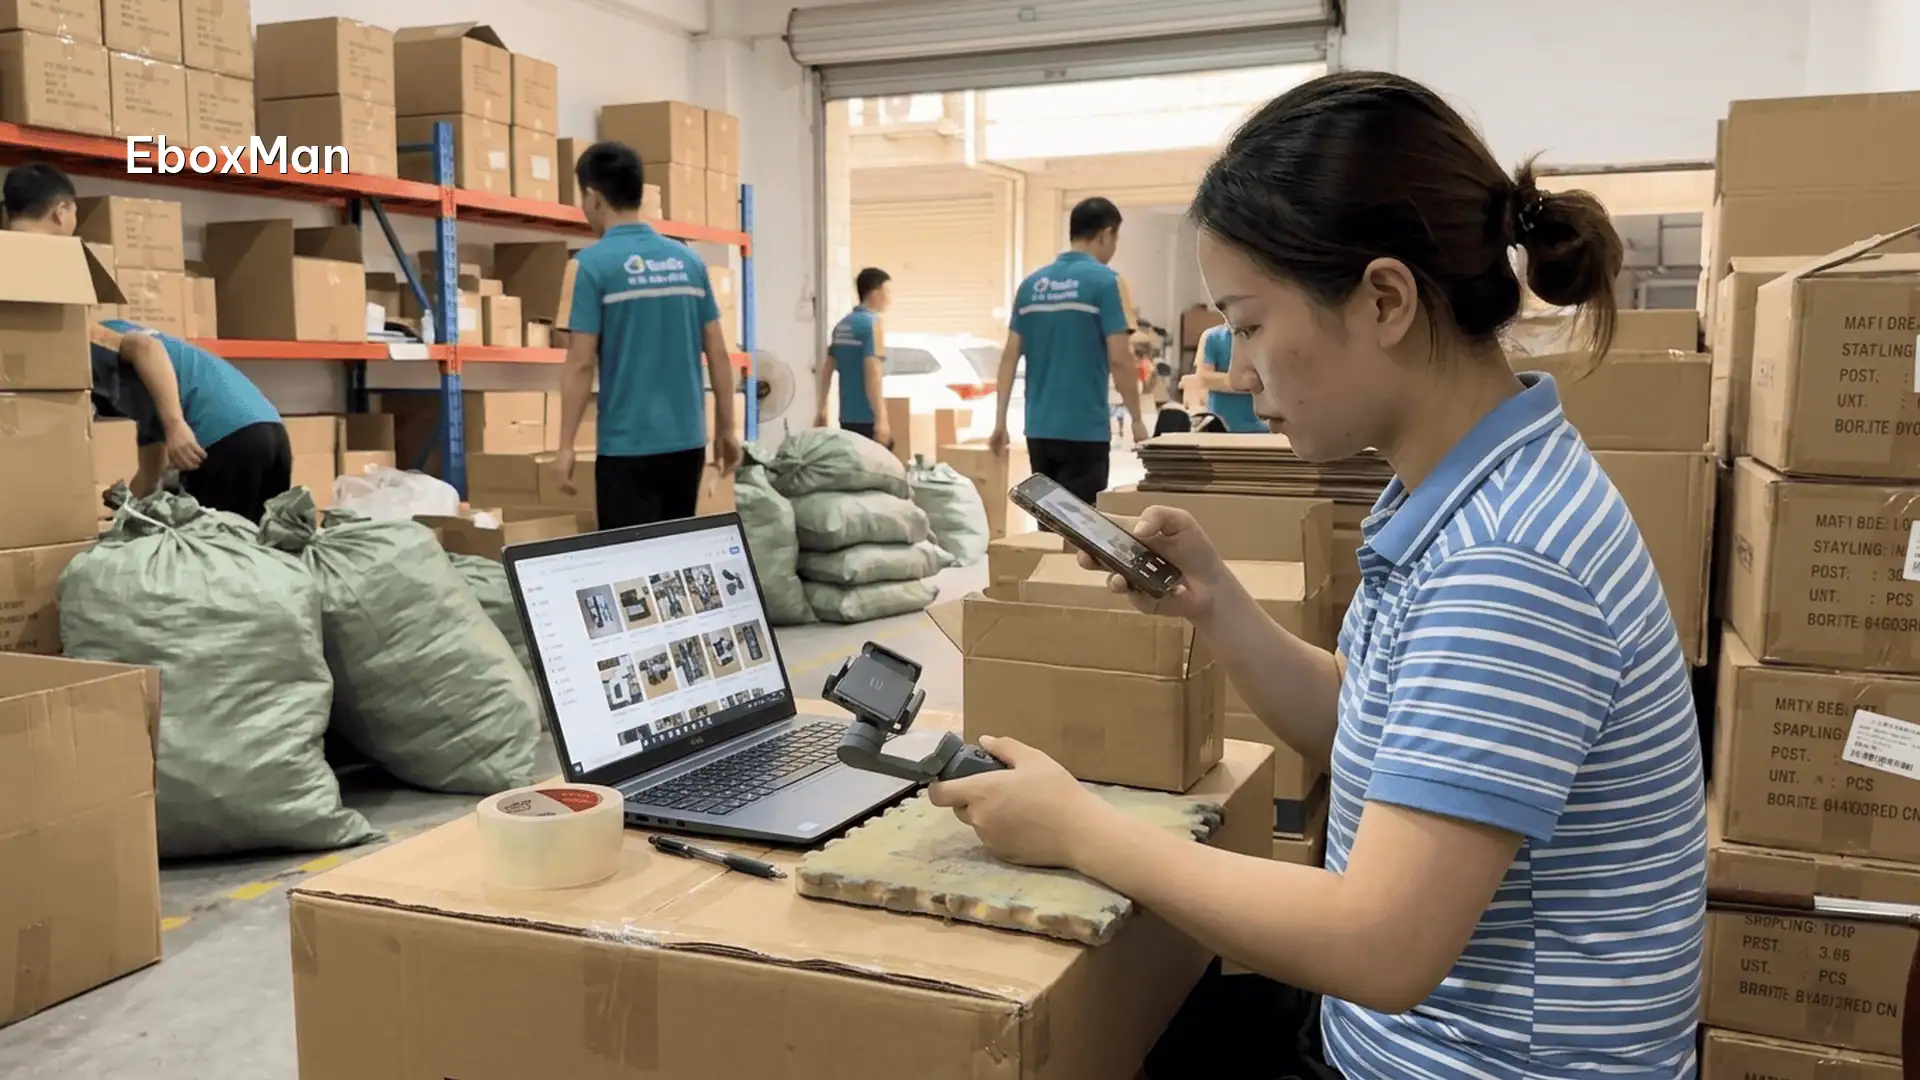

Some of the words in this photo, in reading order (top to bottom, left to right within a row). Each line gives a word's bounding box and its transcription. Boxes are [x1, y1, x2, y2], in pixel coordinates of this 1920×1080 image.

[1842, 343, 1913, 358] STATLING
[1886, 592, 1914, 607] PCS
[1846, 776, 1874, 791] PCS
[1819, 969, 1847, 986] PCS
[1876, 1001, 1898, 1018] CN
